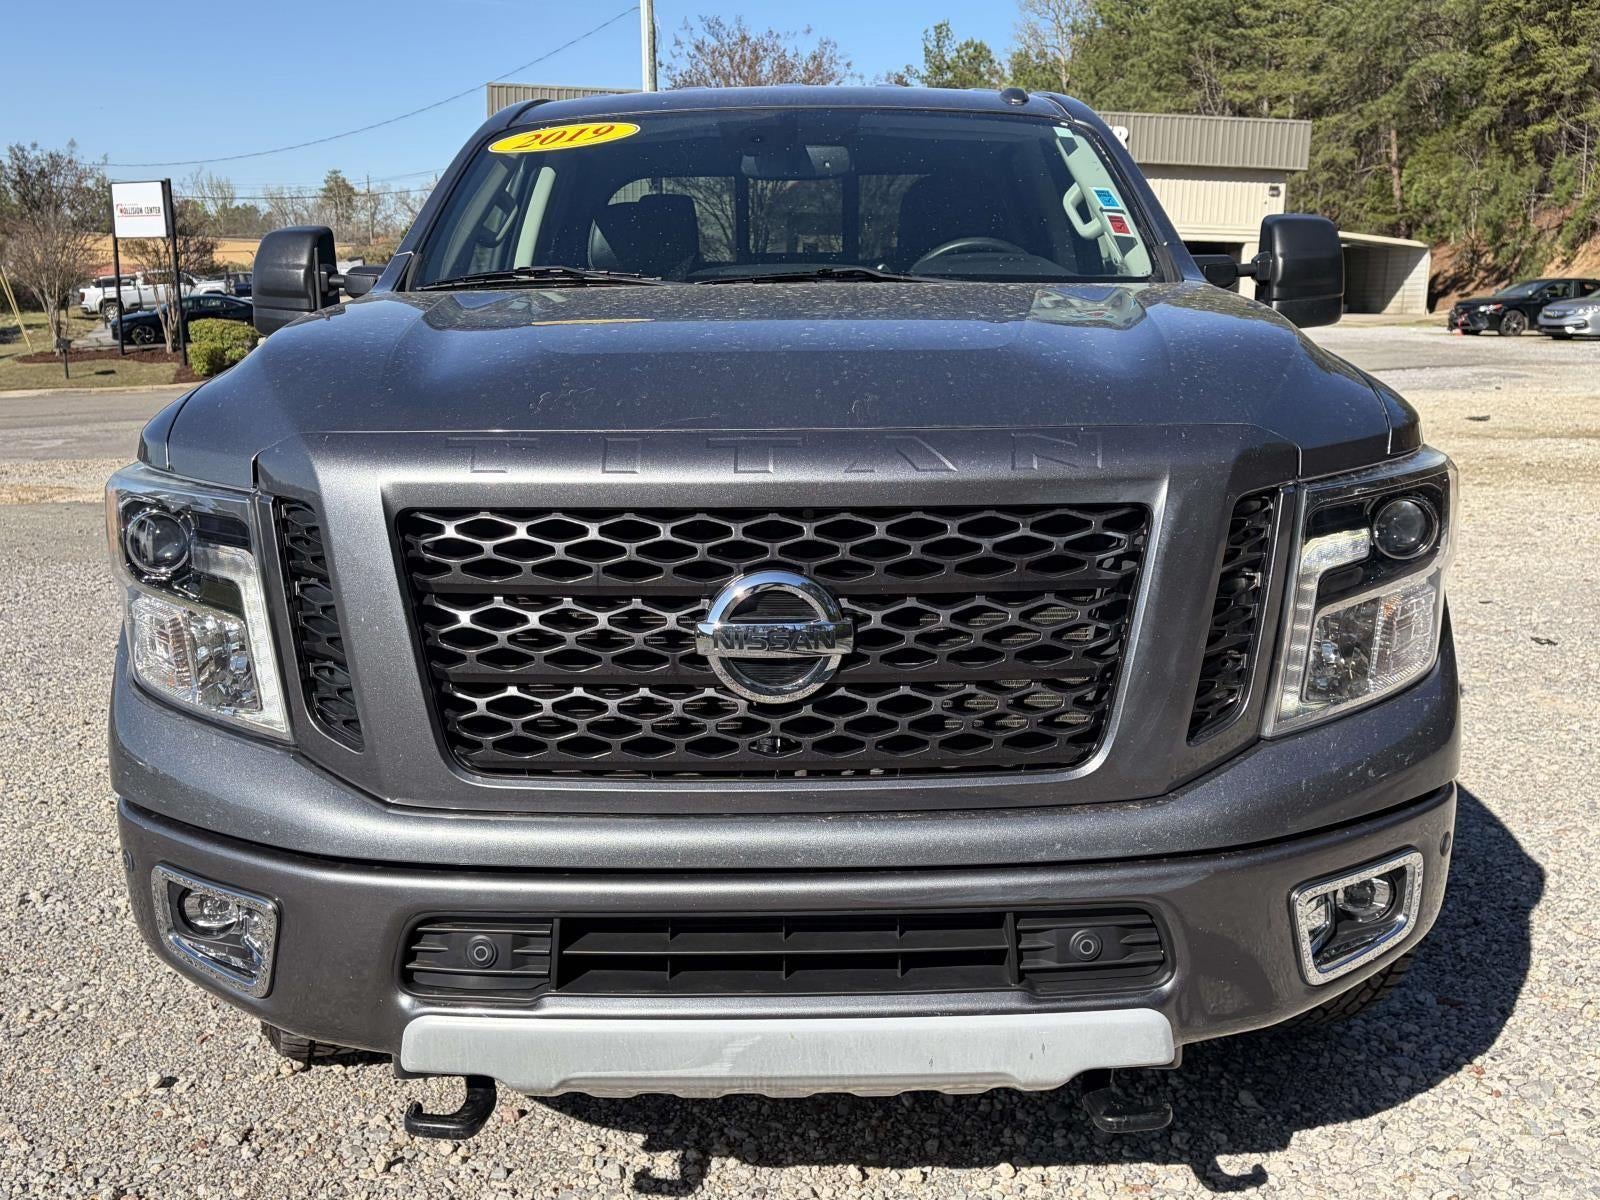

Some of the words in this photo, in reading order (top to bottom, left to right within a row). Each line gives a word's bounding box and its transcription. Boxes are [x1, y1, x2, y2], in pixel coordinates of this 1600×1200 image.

[511, 125, 615, 149] 2019
[144, 206, 161, 215] CENTER
[446, 432, 1104, 474] TITAN
[713, 629, 837, 651] NISSAN
